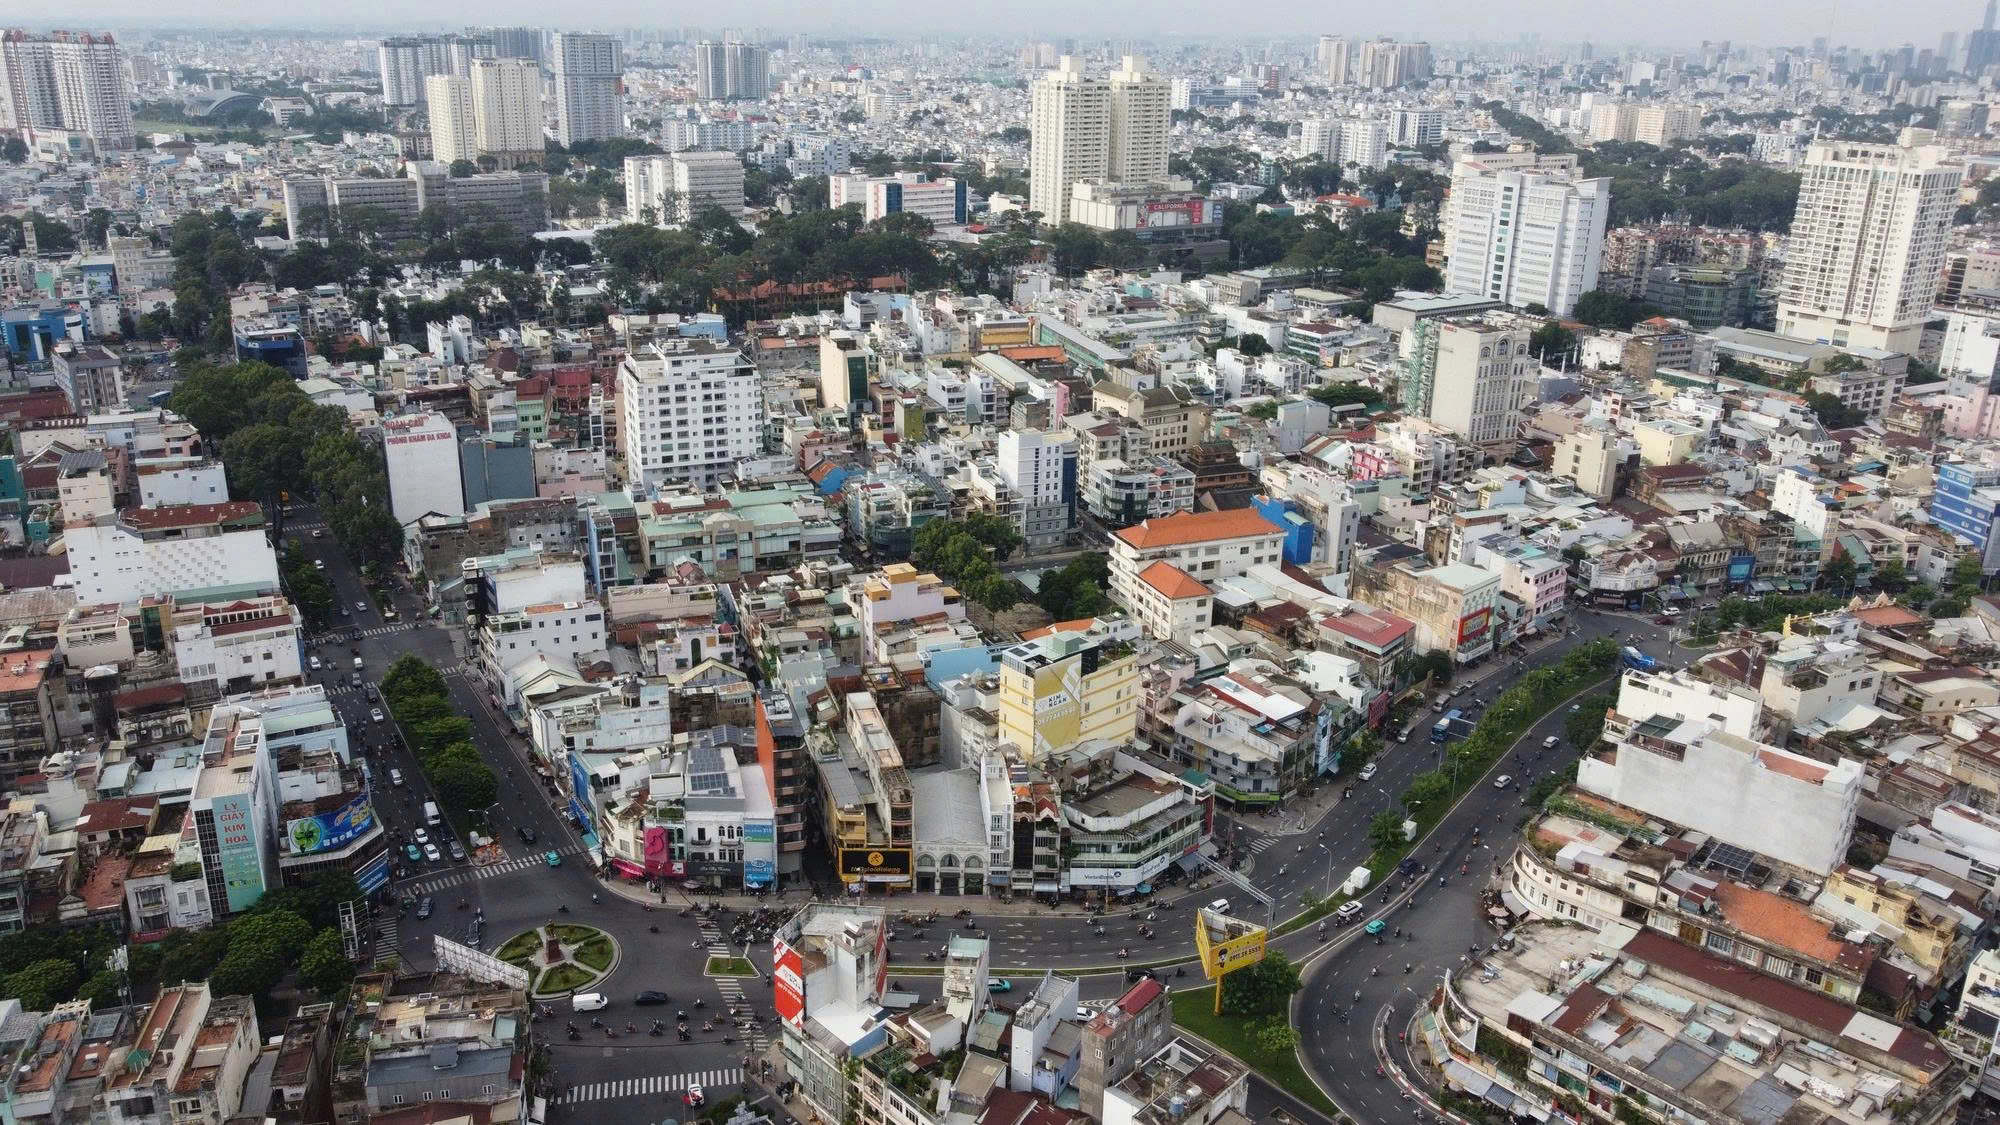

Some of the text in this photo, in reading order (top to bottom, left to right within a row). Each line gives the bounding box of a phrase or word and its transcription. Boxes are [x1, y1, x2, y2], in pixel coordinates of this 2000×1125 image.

[1049, 694, 1061, 702] KIM
[224, 803, 238, 811] LY
[224, 823, 246, 833] KIM
[224, 834, 248, 844] HOA
